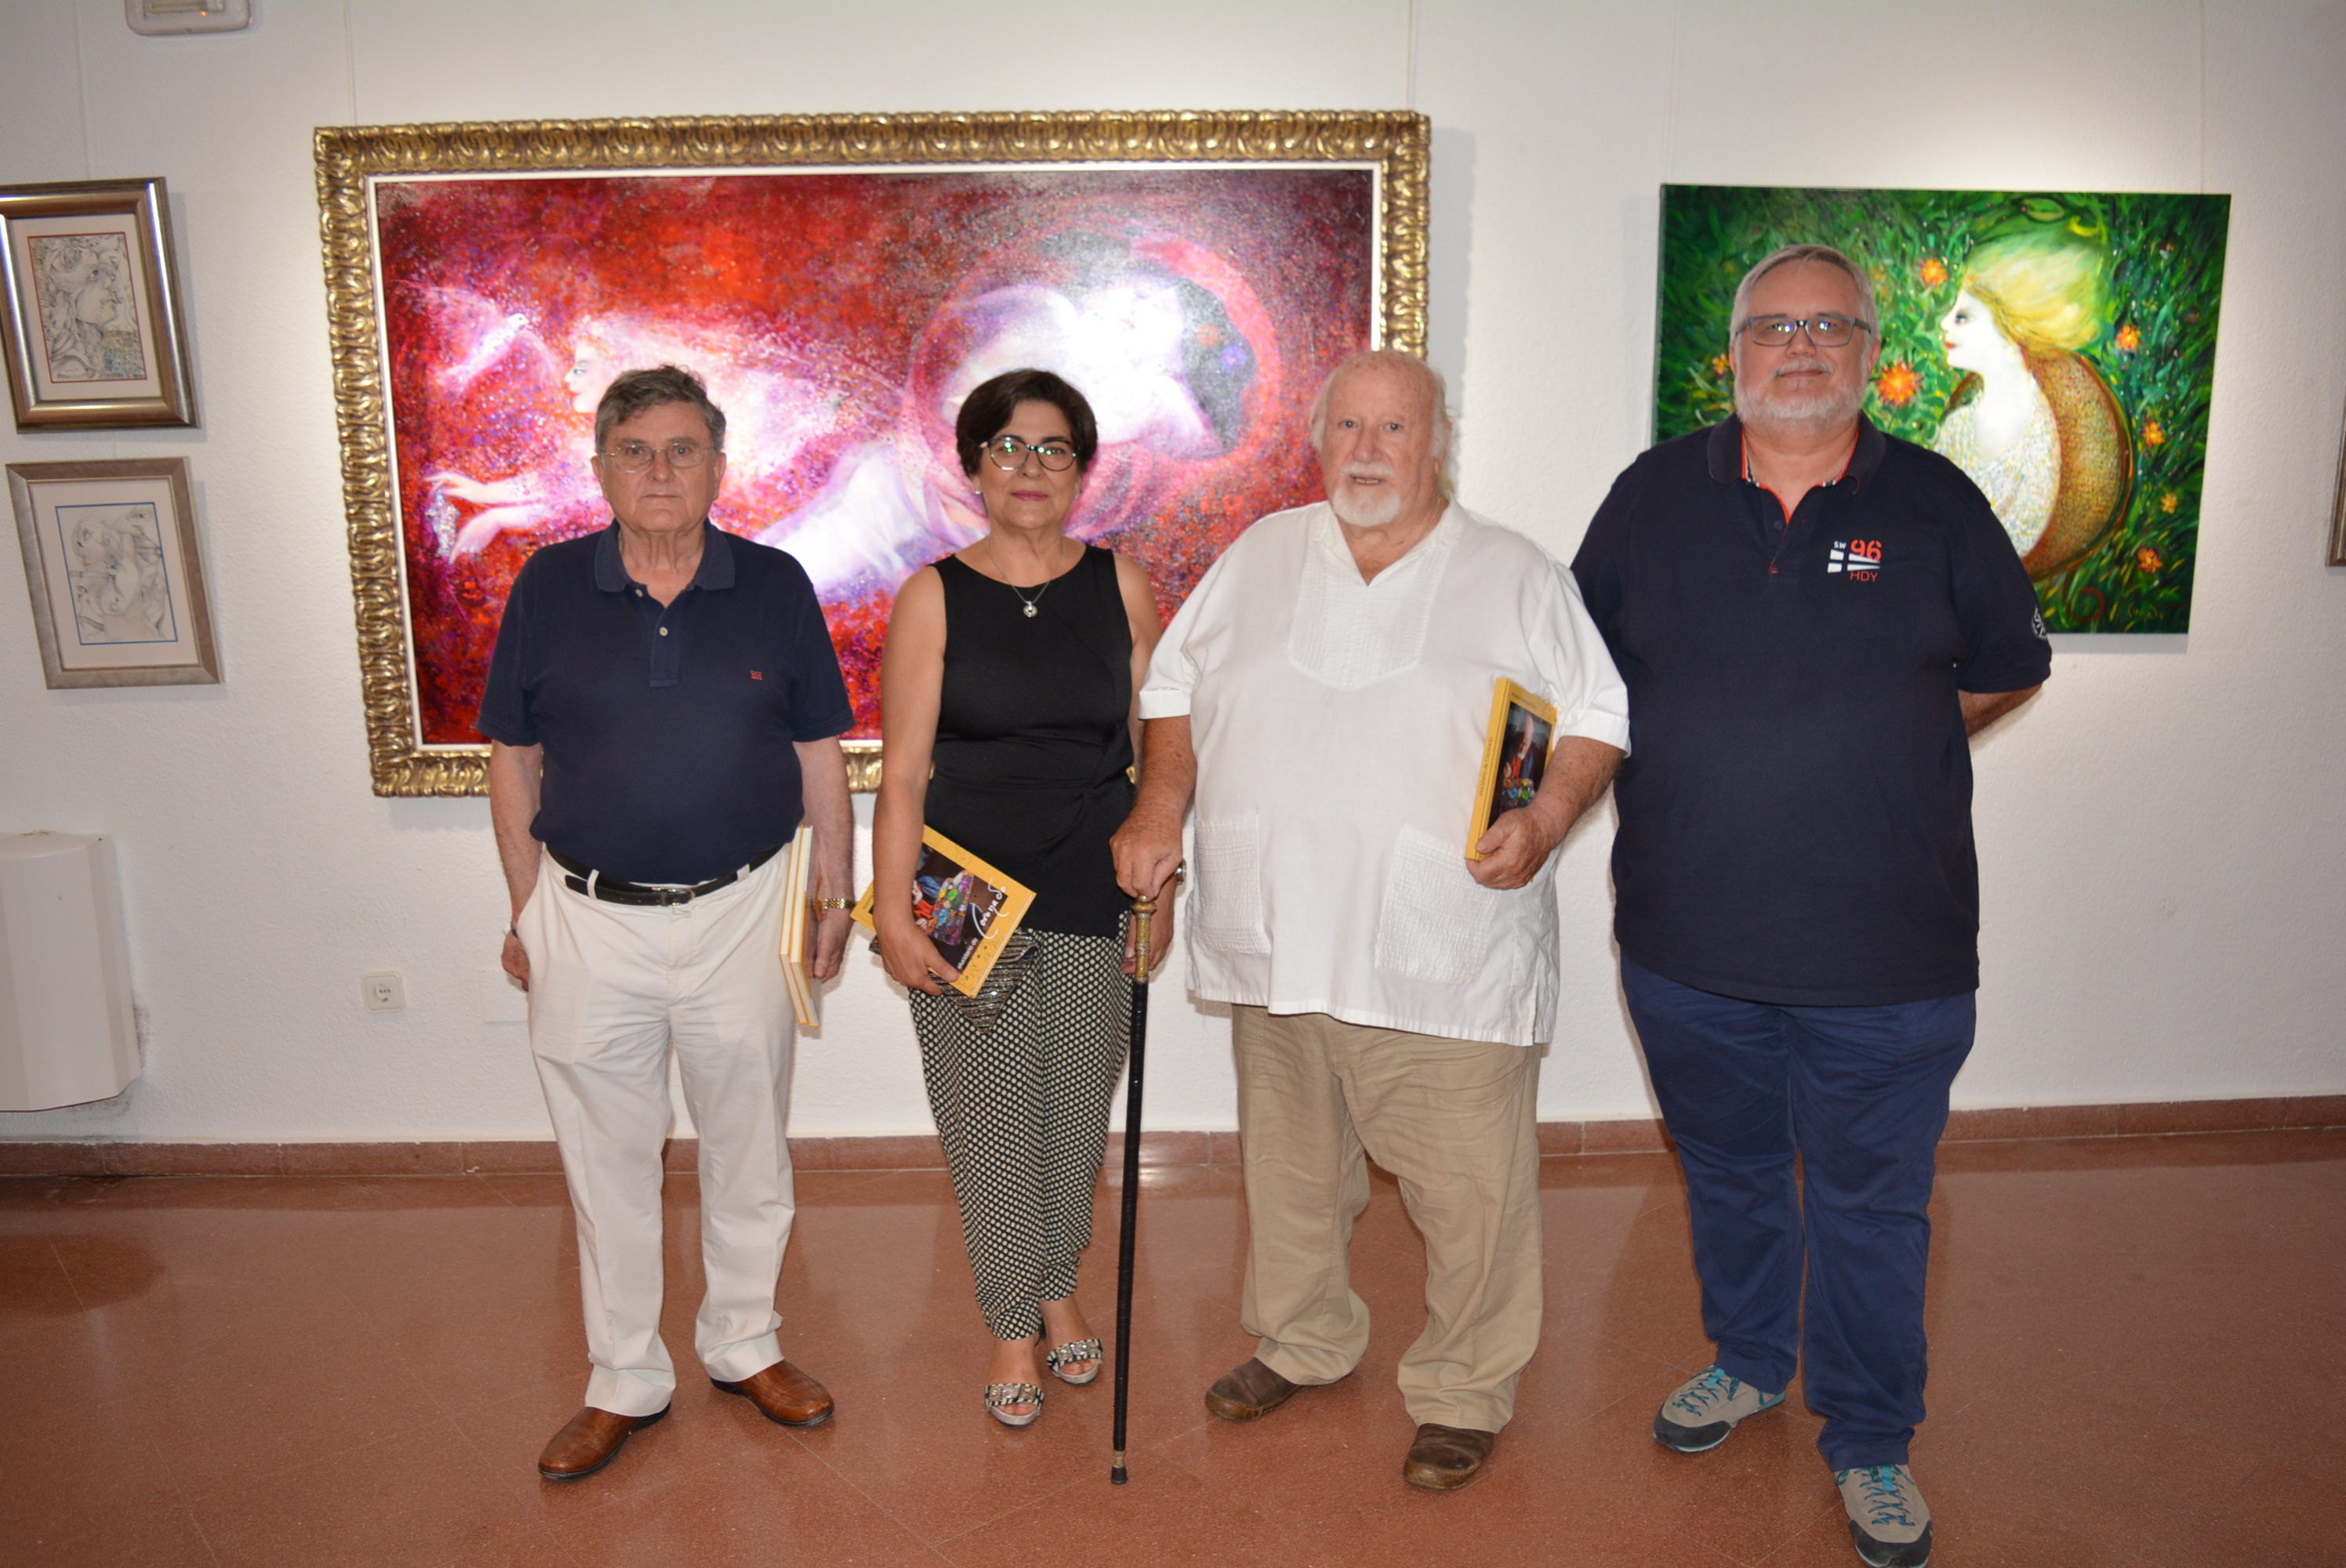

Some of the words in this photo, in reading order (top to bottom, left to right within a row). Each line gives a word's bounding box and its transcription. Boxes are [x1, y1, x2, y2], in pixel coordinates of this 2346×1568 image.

[1850, 539, 1883, 561] 96
[1850, 571, 1878, 582] HDY
[957, 945, 974, 968] elucidario
[970, 878, 1010, 939] Coronado
